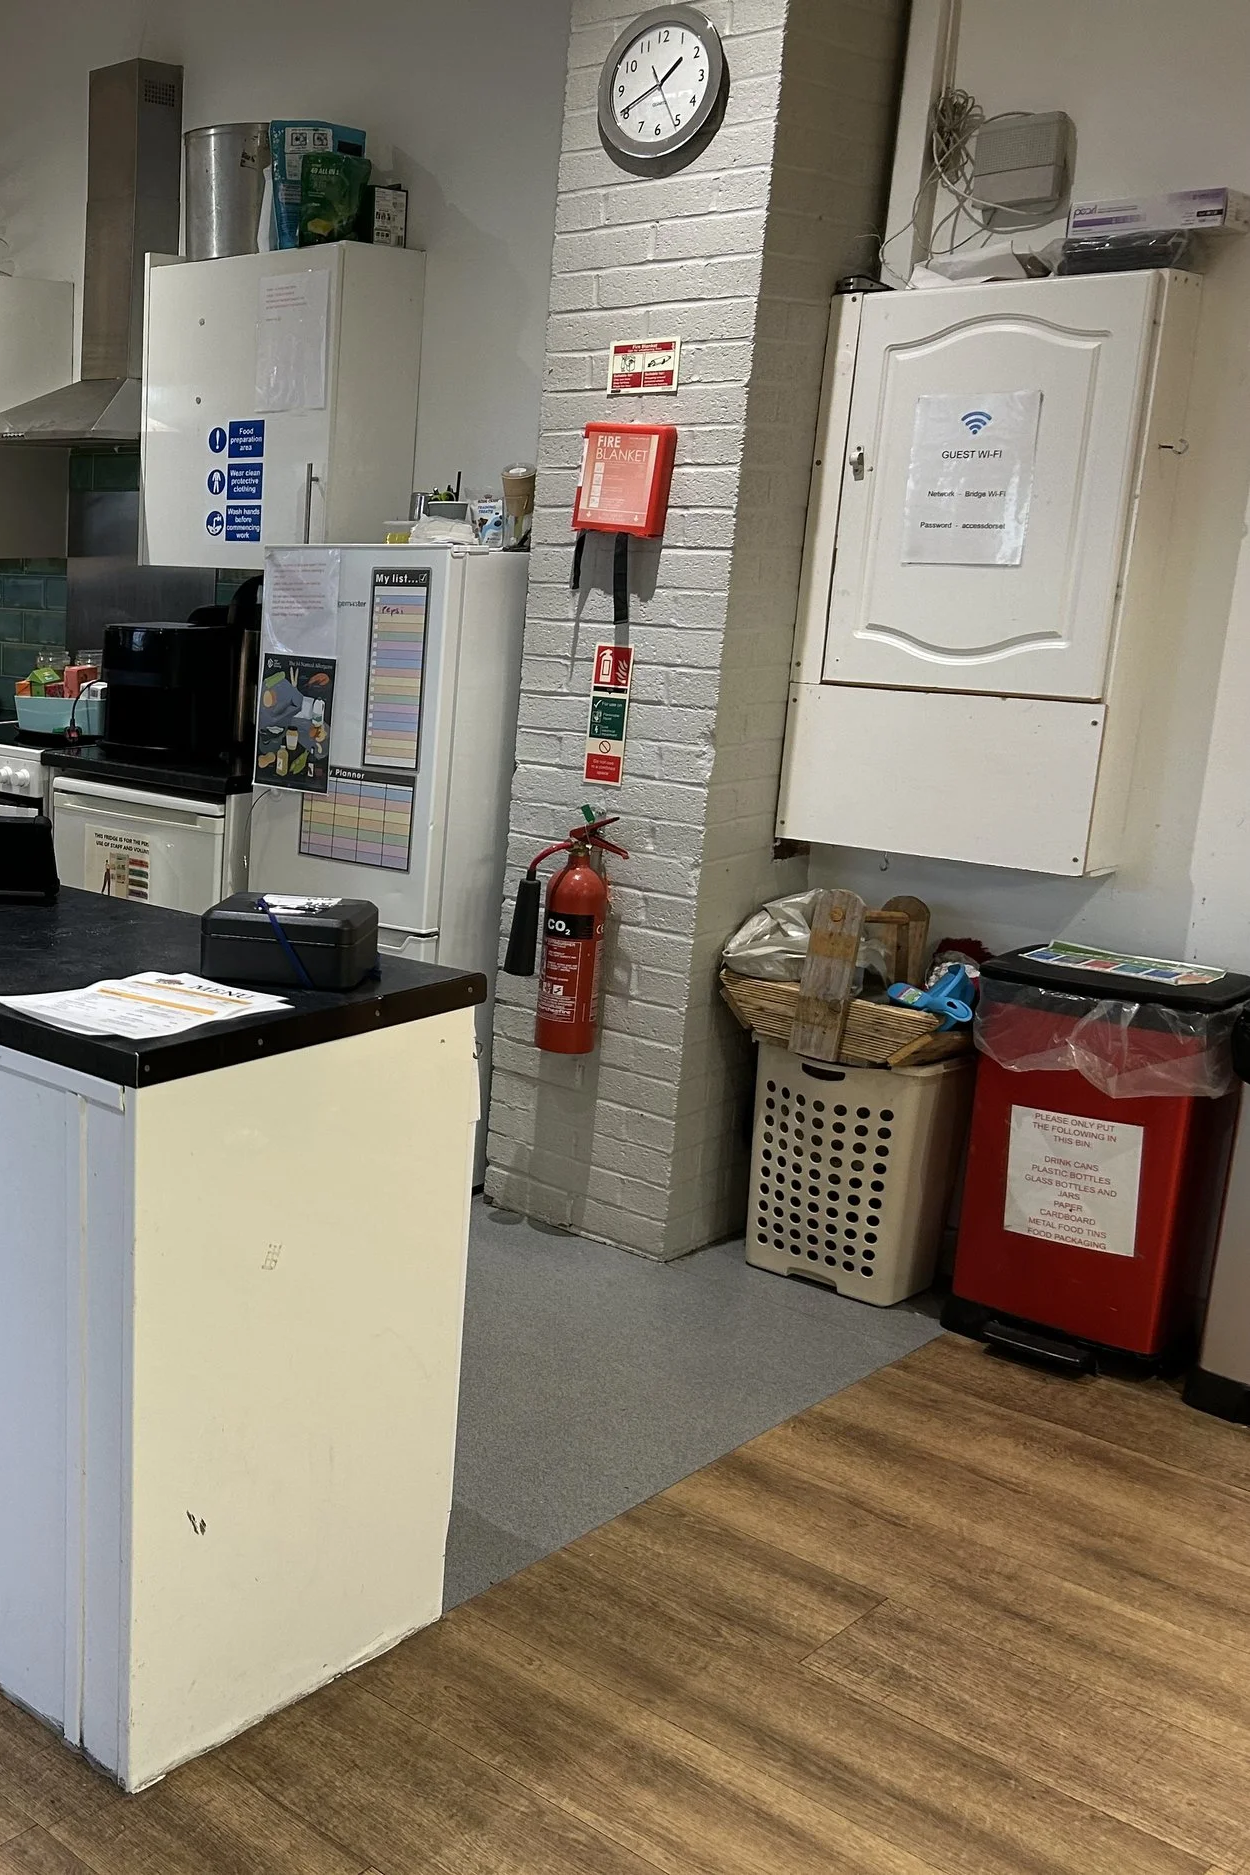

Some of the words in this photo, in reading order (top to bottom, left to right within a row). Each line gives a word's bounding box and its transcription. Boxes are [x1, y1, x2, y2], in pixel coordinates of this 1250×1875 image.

[658, 30, 670, 44] 12
[681, 32, 685, 45] 1
[640, 41, 650, 54] 11
[693, 46, 700, 59] 2
[626, 60, 638, 74] 10
[698, 69, 704, 81] 3
[618, 85, 625, 97] 9
[690, 95, 696, 107] 4
[623, 108, 630, 120] 8
[674, 114, 681, 126] 5
[638, 121, 645, 133] 7
[654, 124, 661, 136] 6
[230, 435, 262, 445] preparation
[597, 435, 621, 448] FIRE
[596, 447, 648, 462] BLANKET
[941, 450, 976, 459] GUEST
[978, 450, 1002, 458] WI-FI
[231, 477, 259, 486] protective
[233, 485, 256, 494] clothing
[226, 524, 260, 533] commencing
[375, 574, 390, 584] My
[335, 769, 365, 780] Planner
[547, 918, 570, 935] CO2
[189, 984, 254, 999] MENU
[1035, 1112, 1069, 1125] PLEASE
[1070, 1120, 1095, 1129] ONLY
[1096, 1123, 1115, 1132] PUT
[1032, 1121, 1049, 1131] THE
[1051, 1125, 1105, 1140] FOLLOWING
[1107, 1135, 1117, 1143] IN
[1053, 1135, 1073, 1145] THIS
[1044, 1156, 1072, 1167] DRINK
[1073, 1162, 1099, 1172] CANS
[1032, 1164, 1068, 1177] PLASTIC
[1069, 1172, 1111, 1185] BOTTLES
[1025, 1174, 1053, 1186] GLASS
[1055, 1180, 1096, 1194] BOTTLES
[1097, 1188, 1117, 1198] AND
[1058, 1191, 1080, 1200] JARS
[1053, 1200, 1083, 1212] PAPER
[1039, 1208, 1096, 1226] CARDBOARD
[1028, 1217, 1056, 1230] METAL
[1058, 1223, 1084, 1234] FOOD
[1086, 1229, 1107, 1239] TINS
[1027, 1227, 1052, 1238] FOOD
[1054, 1233, 1107, 1250] PACKAGING
